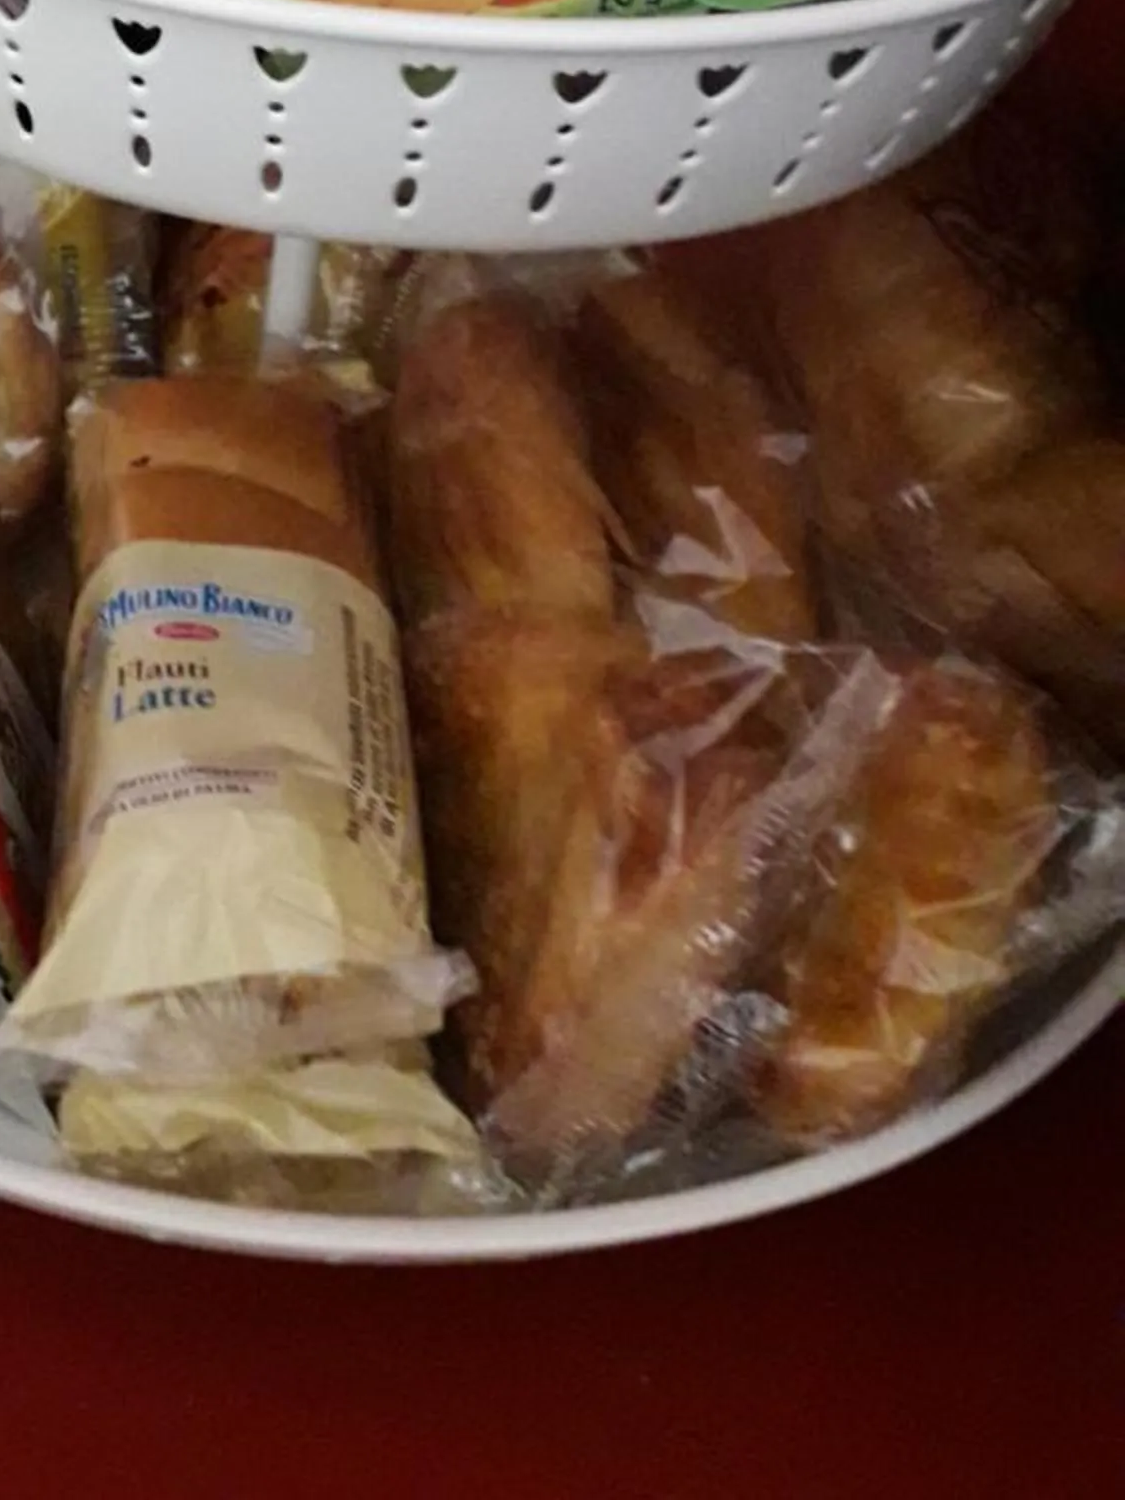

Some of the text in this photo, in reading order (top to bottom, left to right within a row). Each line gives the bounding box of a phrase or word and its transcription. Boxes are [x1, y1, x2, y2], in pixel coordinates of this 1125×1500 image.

[203, 582, 294, 626] BIANCO
[116, 656, 210, 688] Flauti
[113, 686, 217, 724] Latte
